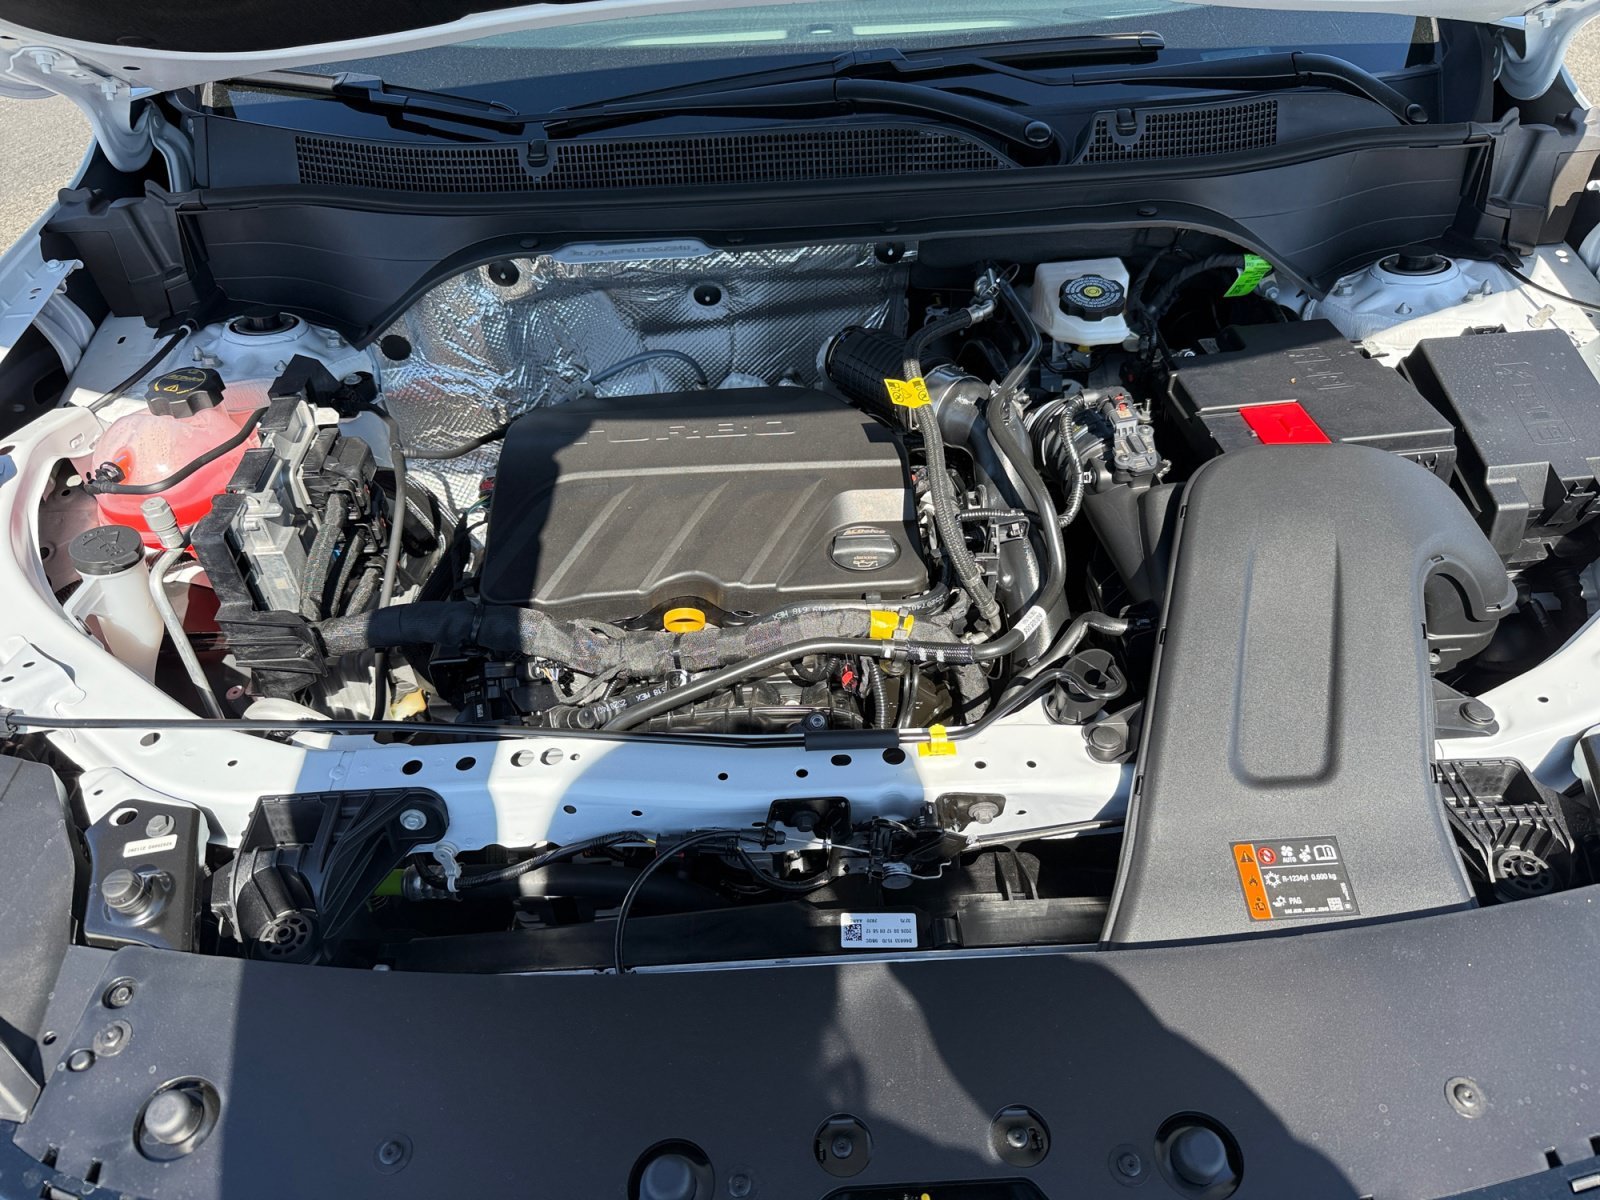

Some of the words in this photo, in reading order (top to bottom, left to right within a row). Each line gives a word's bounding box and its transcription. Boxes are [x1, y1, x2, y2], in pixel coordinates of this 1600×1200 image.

[561, 420, 797, 445] TURBO
[635, 691, 651, 702] MEX
[1282, 873, 1309, 883] R-1234yf
[1329, 872, 1337, 880] kg
[1288, 896, 1303, 905] PAG
